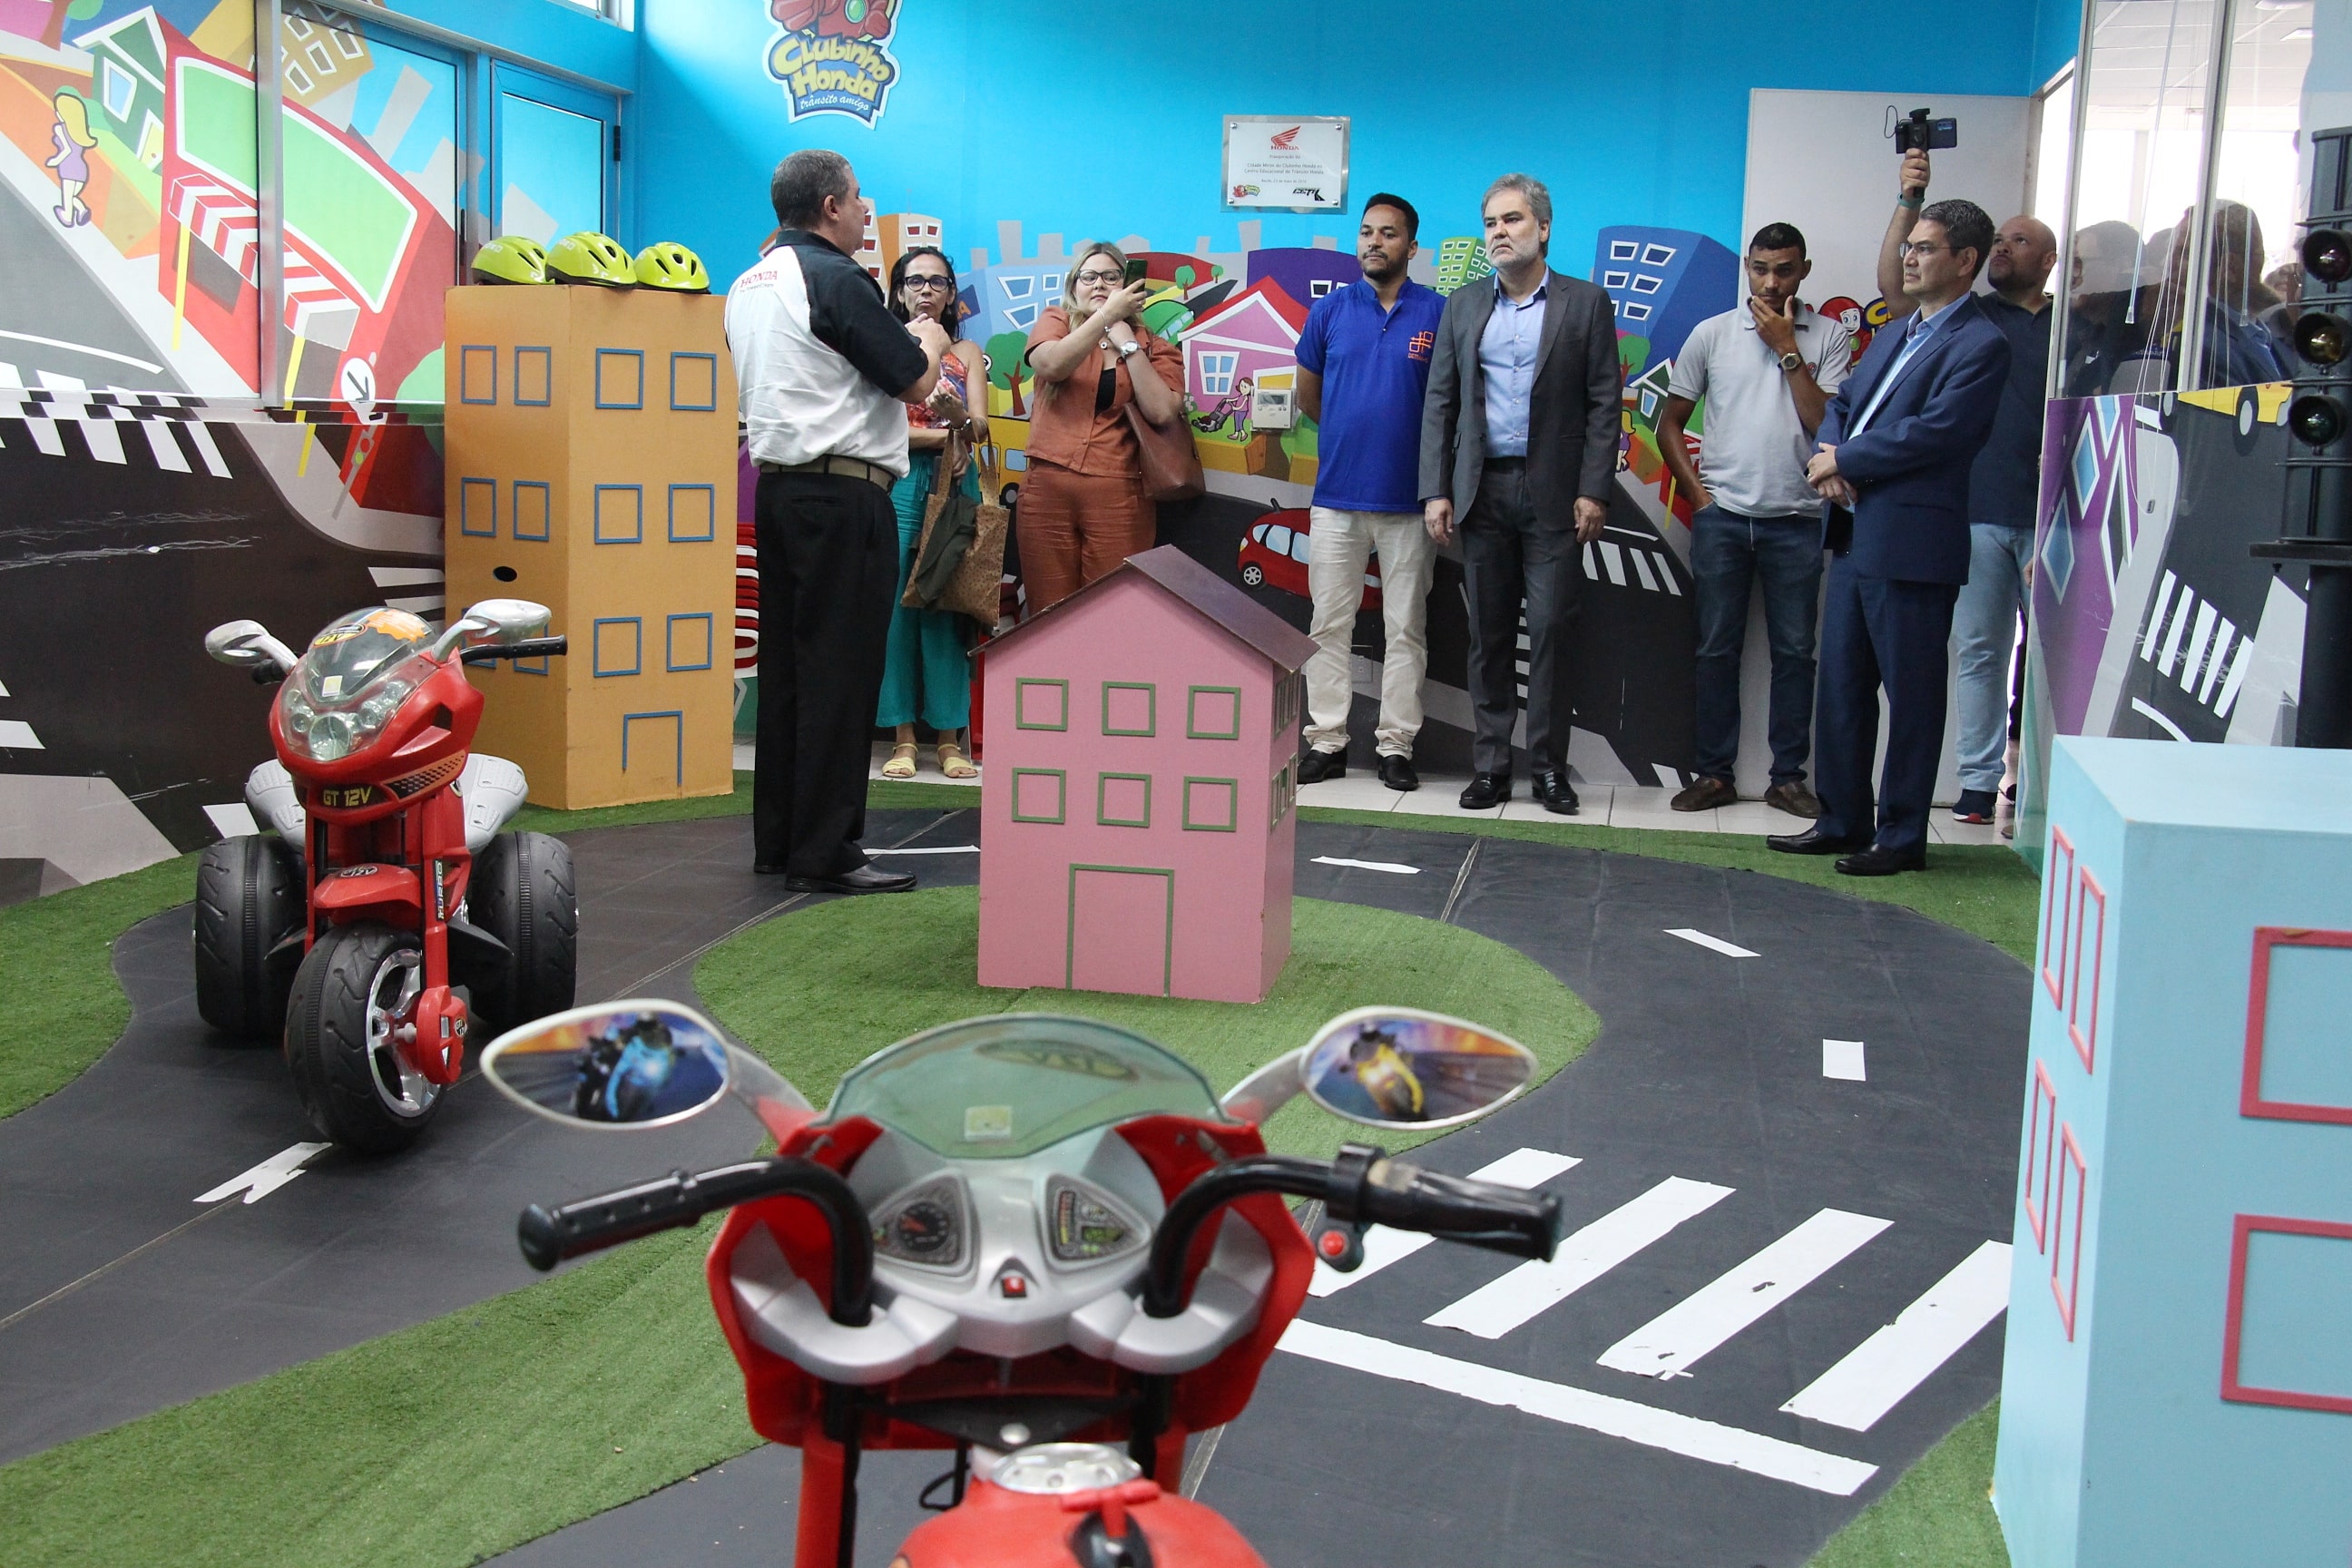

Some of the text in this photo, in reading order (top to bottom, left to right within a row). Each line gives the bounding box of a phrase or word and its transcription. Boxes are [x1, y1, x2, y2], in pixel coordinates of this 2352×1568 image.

[774, 36, 891, 83] Clubinho
[792, 63, 880, 102] Honda
[800, 94, 869, 111] trânsito amigo
[740, 270, 779, 288] HONDA
[323, 786, 372, 807] GT 12V
[435, 859, 445, 919] TURBO
